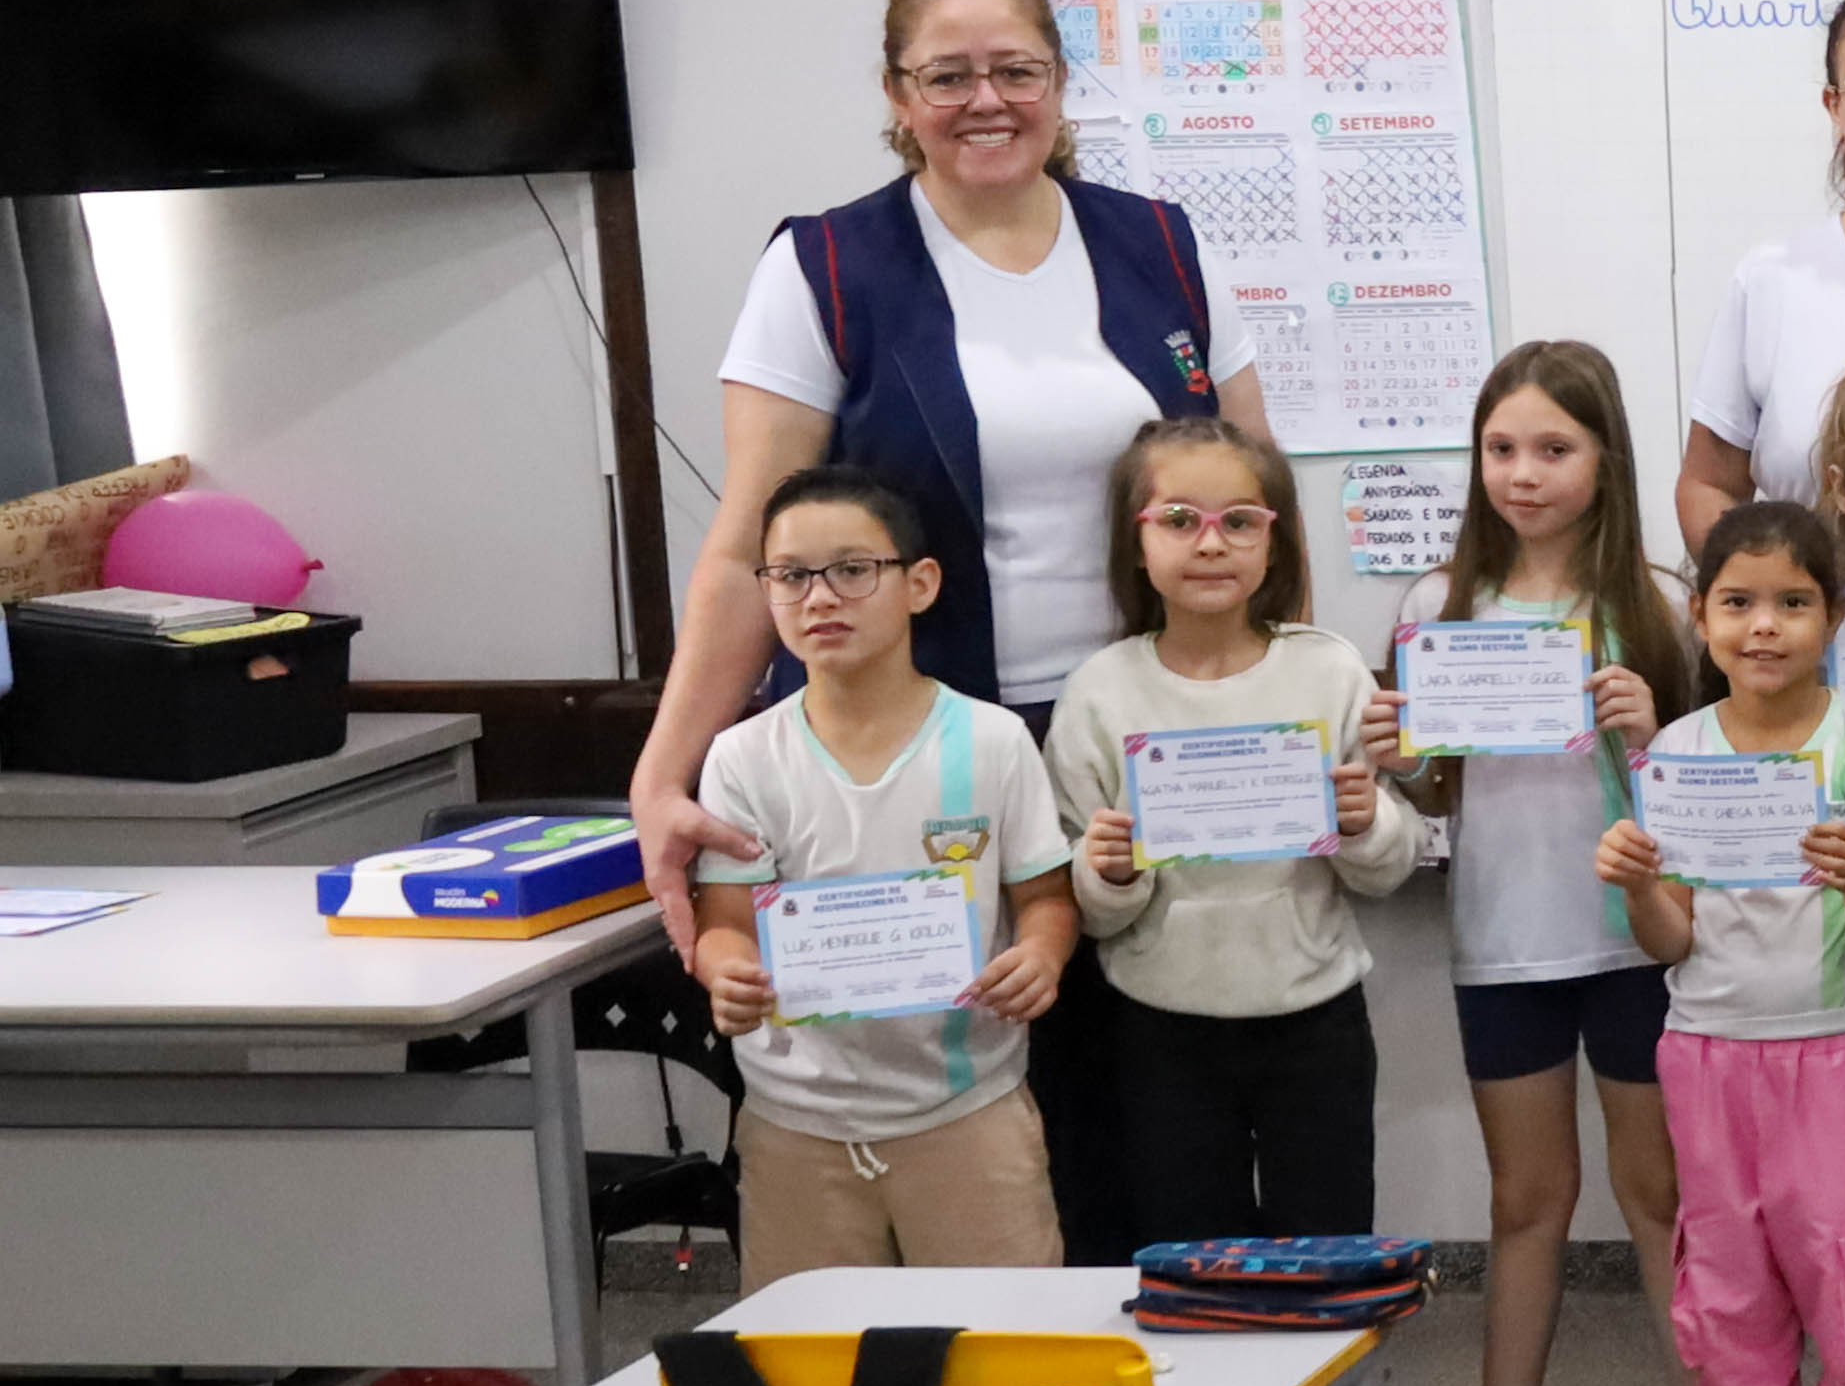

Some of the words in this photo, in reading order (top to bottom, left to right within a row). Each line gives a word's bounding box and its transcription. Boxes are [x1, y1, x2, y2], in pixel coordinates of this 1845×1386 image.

[1182, 116, 1254, 130] AGOSTO
[1340, 116, 1434, 130] SETEMBRO
[1355, 284, 1451, 299] DEZEMBRO
